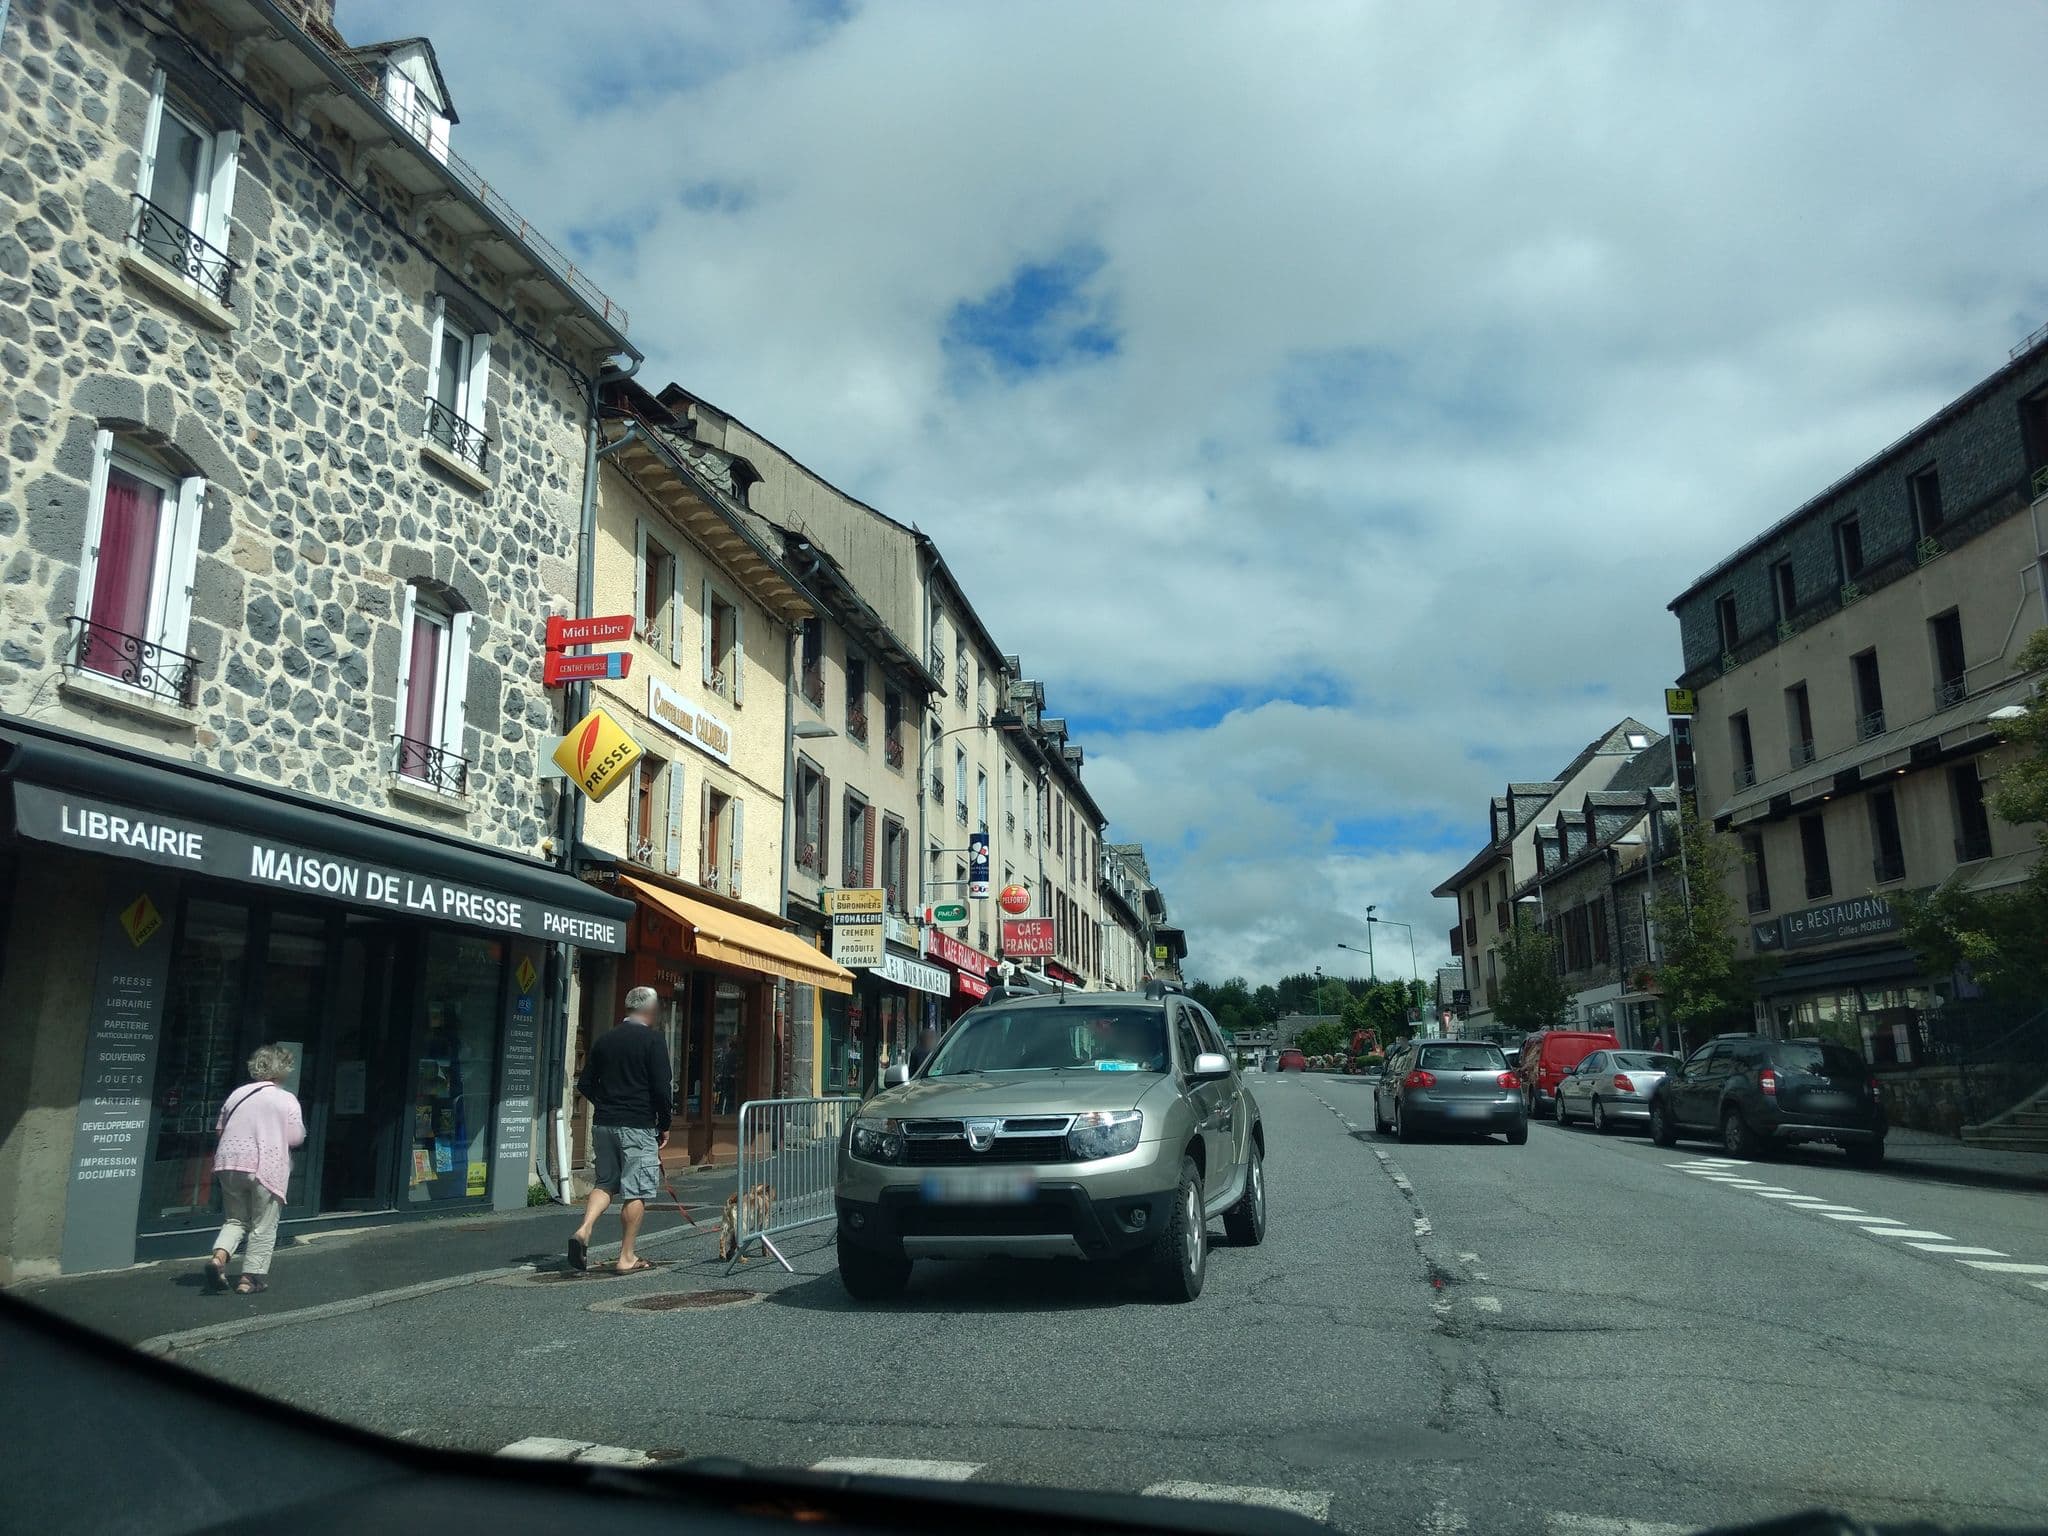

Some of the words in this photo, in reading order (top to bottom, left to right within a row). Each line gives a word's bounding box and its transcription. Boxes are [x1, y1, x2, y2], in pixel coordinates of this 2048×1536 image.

[562, 625, 589, 639] Midi
[593, 623, 624, 637] Libre
[560, 664, 583, 673] CENTRE
[584, 662, 606, 672] PRESSE
[585, 742, 632, 793] PRESSE
[61, 805, 203, 860] LIBRAIRIE
[250, 845, 359, 897] MAISON
[366, 871, 401, 905] DE
[406, 880, 437, 912] LA
[443, 888, 522, 928] PRESSE
[837, 893, 850, 901] LES
[836, 901, 882, 910] BURONNIERS
[835, 913, 882, 924] FROMAGERIE
[1789, 916, 1803, 932] Le
[1807, 898, 1890, 929] RESTAURANT
[543, 912, 615, 944] PAPETERIE
[841, 928, 875, 937] CREMERIE
[1017, 922, 1041, 936] CAFE
[1838, 926, 1858, 937] Gilles
[1860, 918, 1892, 931] MOREAU
[841, 944, 874, 953] PRODUITS
[1006, 937, 1053, 953] FRANÇAIS
[836, 956, 878, 965] REGIONAUX
[112, 976, 153, 987] PRESSE
[106, 998, 153, 1009] LIBRAIRIE
[104, 1020, 150, 1030] PAPETERIE
[99, 1052, 146, 1062] SOUVENIRS
[97, 1074, 144, 1083] JOUETS
[94, 1097, 141, 1106] CARTERIE
[82, 1120, 146, 1131] DEVELOPPEMENT
[93, 1133, 132, 1143] PHOTOS
[500, 1142, 529, 1150] IMPRESSION
[499, 1150, 529, 1159] DOCUMENTS
[80, 1157, 138, 1167] IMPRESSION
[78, 1168, 137, 1180] DOCUMENTS
